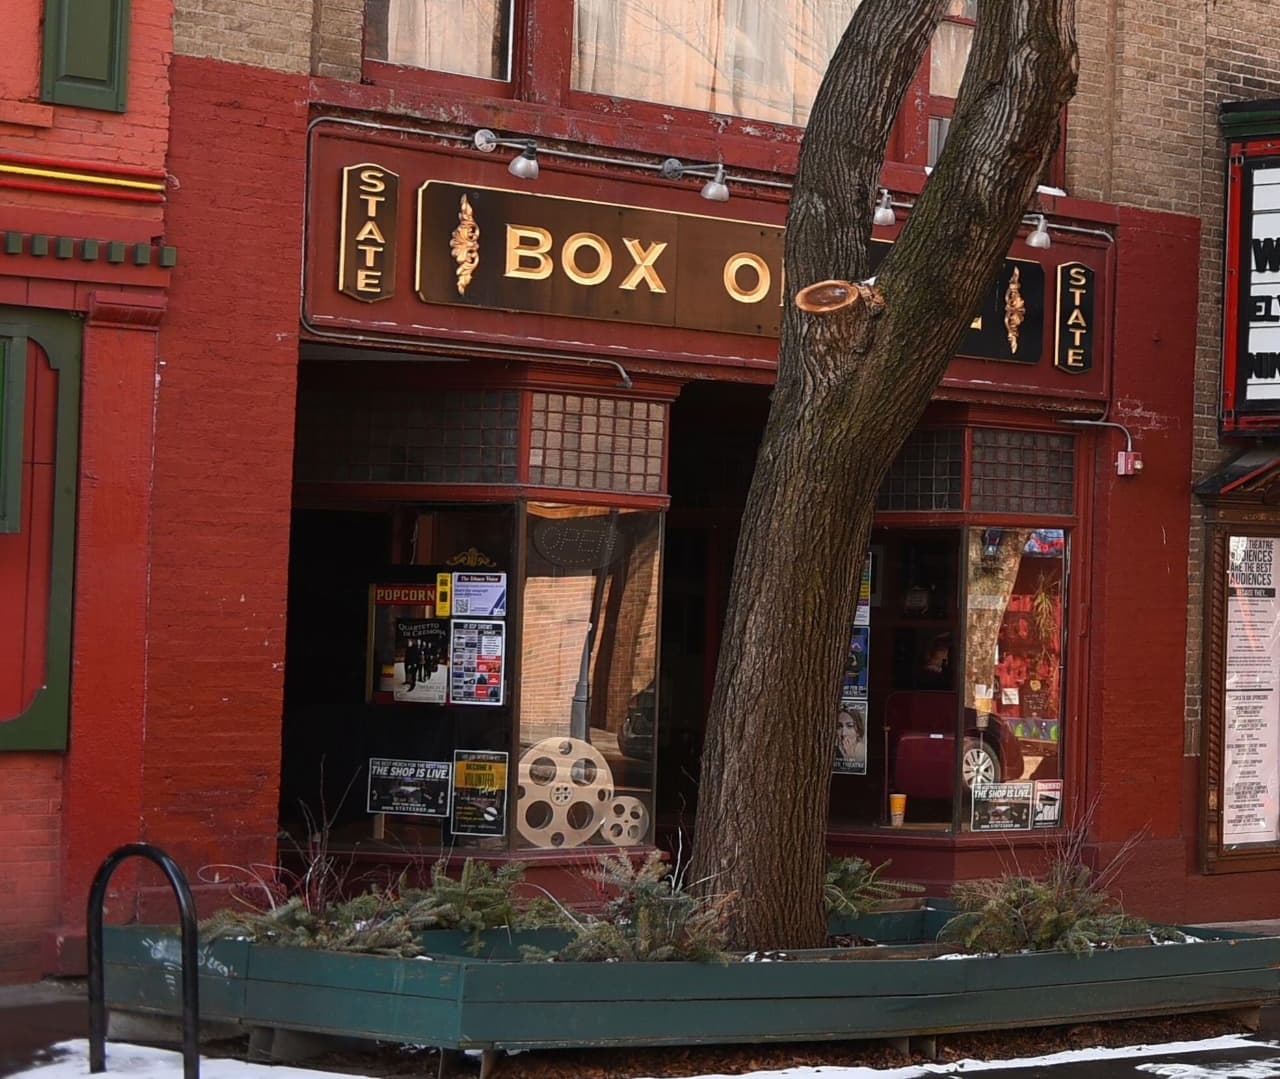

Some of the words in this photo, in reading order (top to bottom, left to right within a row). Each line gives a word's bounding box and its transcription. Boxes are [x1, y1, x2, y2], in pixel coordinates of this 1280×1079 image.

[356, 169, 386, 293] STATE
[503, 223, 668, 294] BOX
[1066, 268, 1087, 367] STATE
[1231, 549, 1273, 563] DIENCES
[1244, 562, 1255, 573] THE
[1256, 562, 1273, 573] BEST
[1230, 572, 1272, 586] AUDIENCES
[376, 589, 436, 601] POPCORN
[372, 766, 389, 776] THE
[390, 767, 415, 777] SHOP
[416, 768, 426, 778] IS
[426, 769, 449, 779] LIVE.
[988, 789, 1006, 798] SHOP
